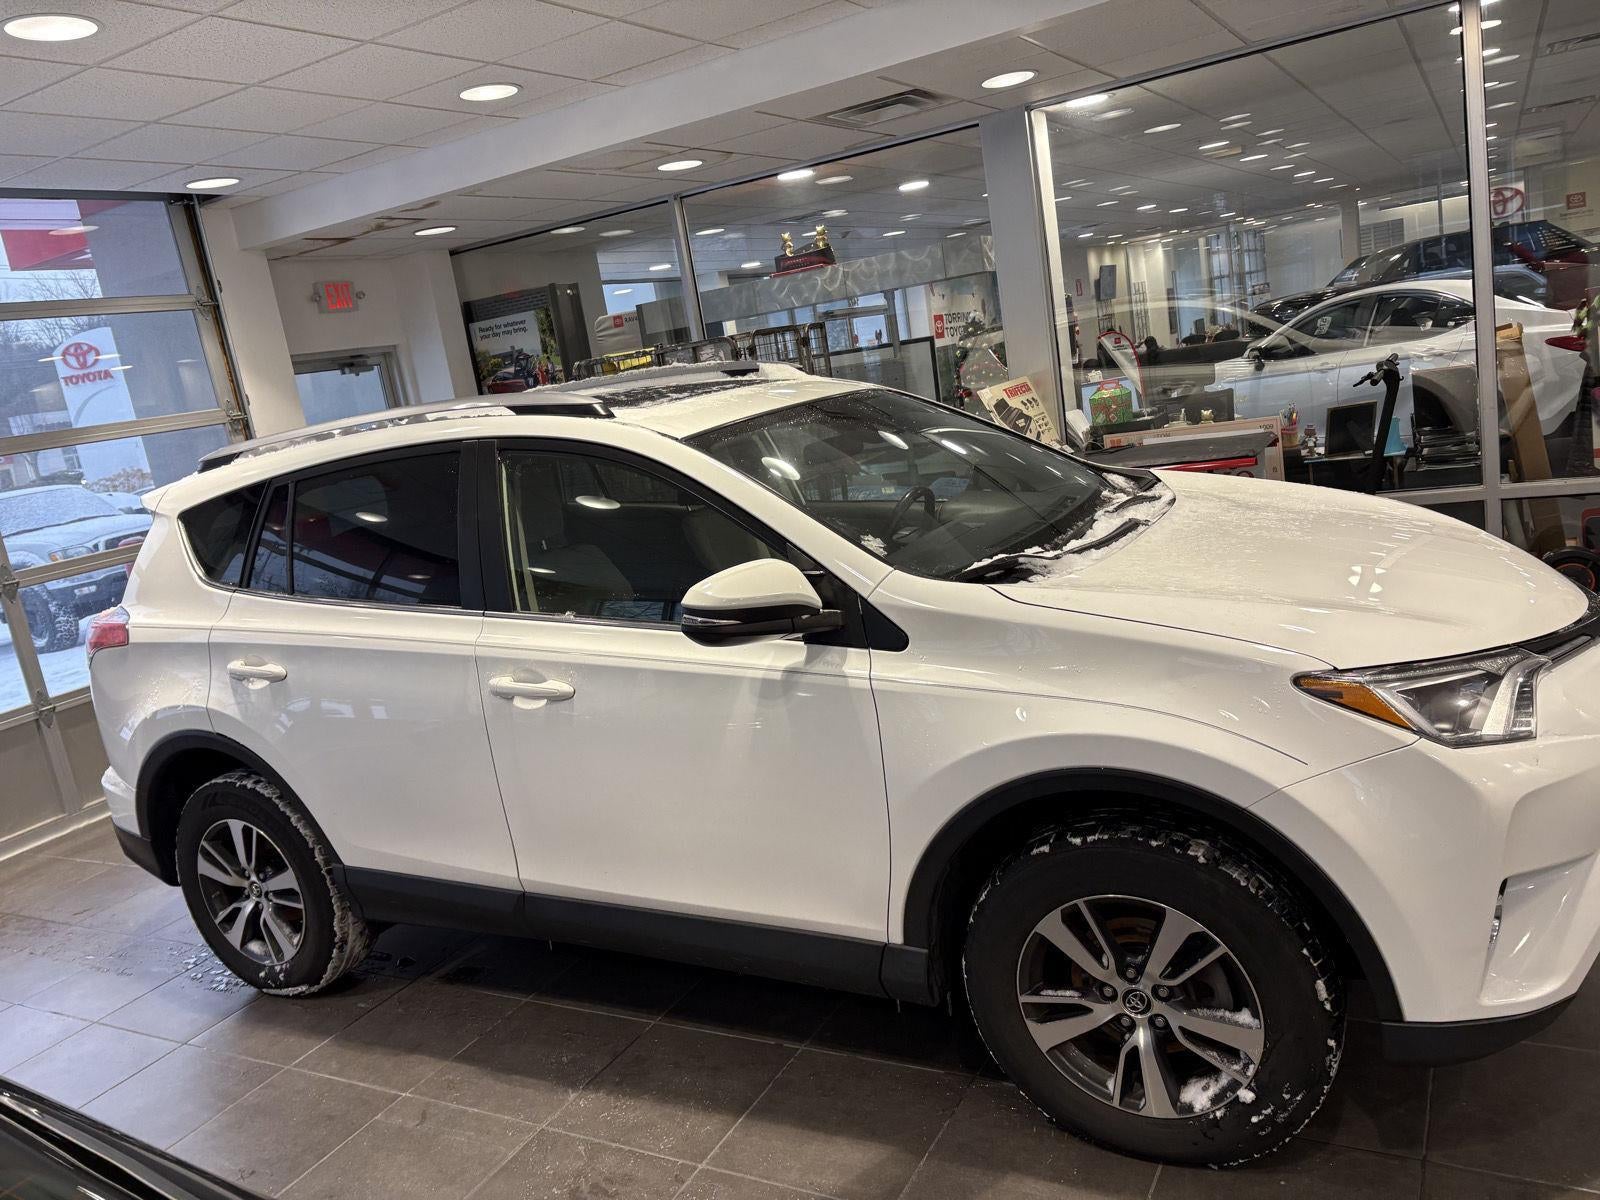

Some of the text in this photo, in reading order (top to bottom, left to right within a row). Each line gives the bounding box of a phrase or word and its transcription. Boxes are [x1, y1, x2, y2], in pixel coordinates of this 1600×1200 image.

[324, 283, 353, 309] EXIT
[478, 325, 494, 334] Ready
[503, 319, 527, 328] whatever
[944, 312, 970, 325] TORRIN
[480, 333, 491, 341] your
[492, 331, 501, 339] day
[512, 325, 529, 334] bring.
[945, 325, 964, 338] TOYO
[61, 369, 113, 386] TOYOTA
[1003, 382, 1034, 399] TRIFECTA
